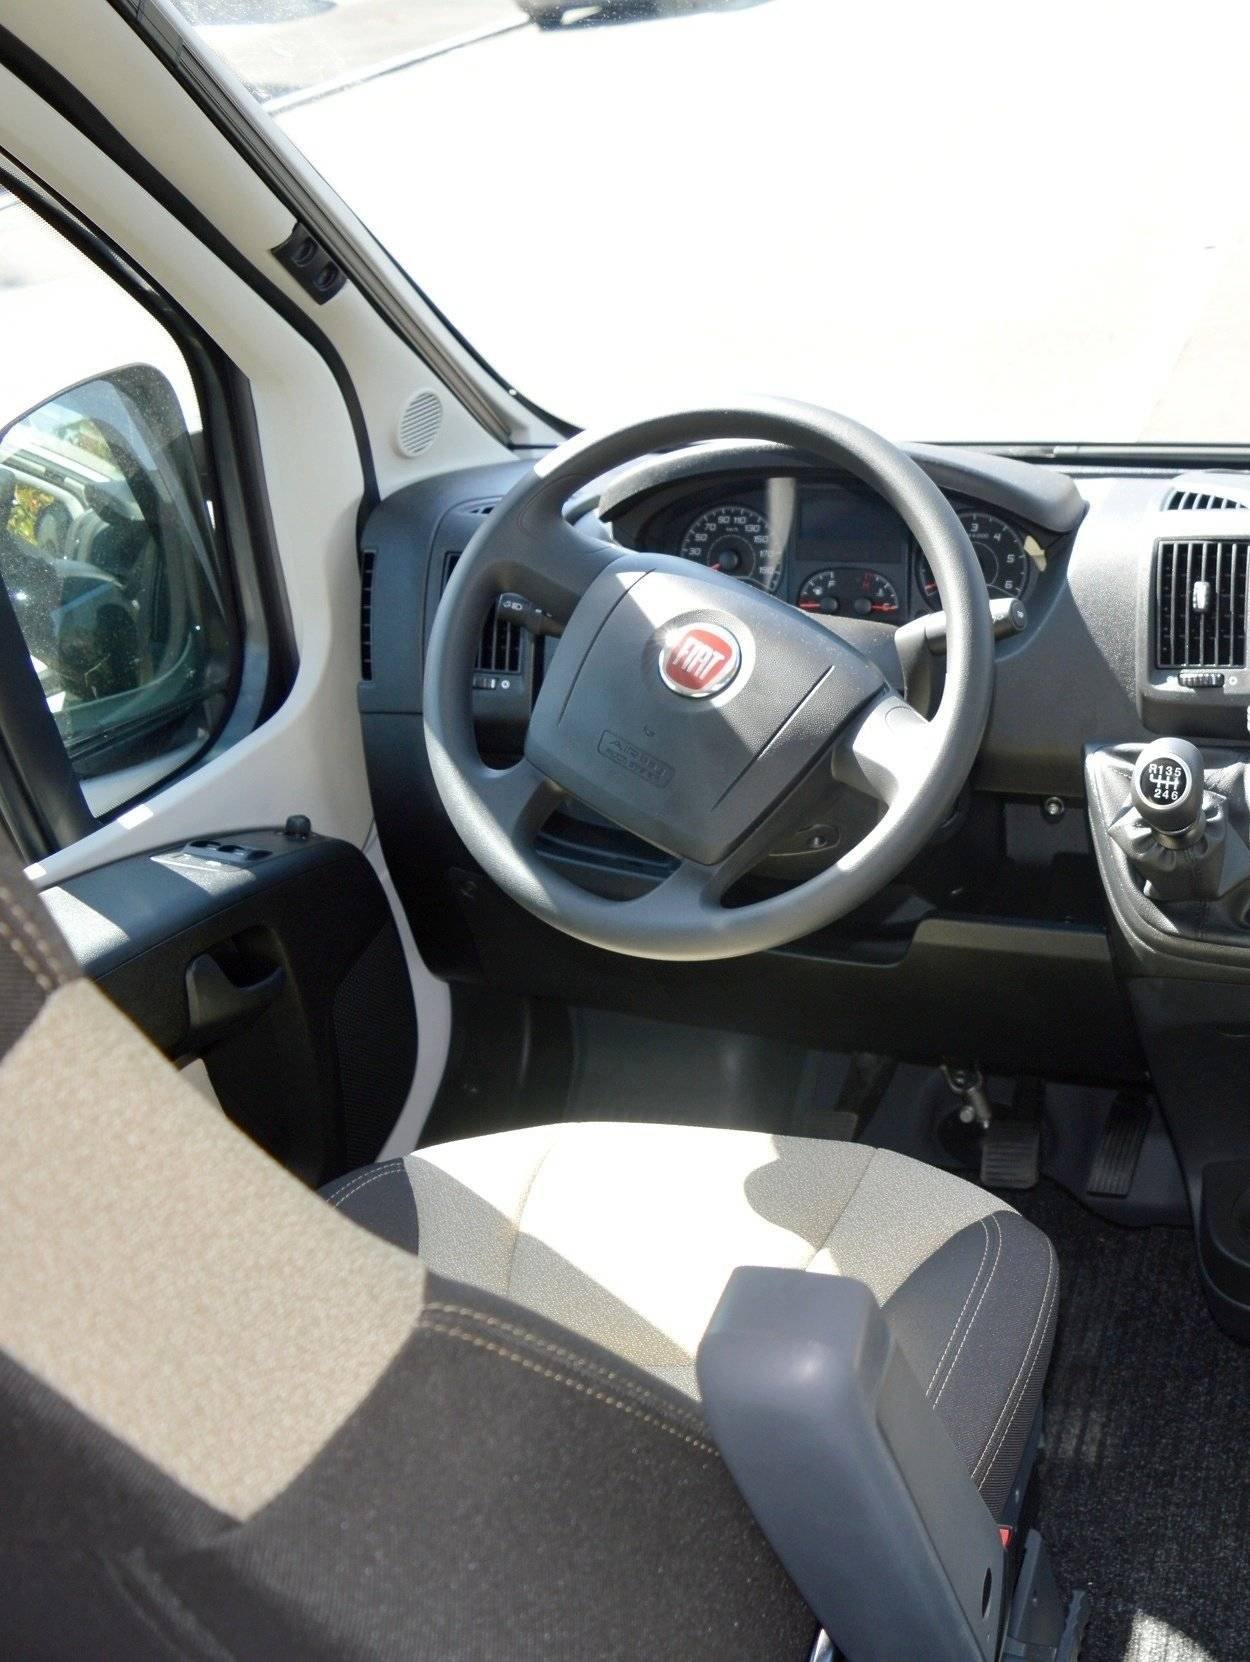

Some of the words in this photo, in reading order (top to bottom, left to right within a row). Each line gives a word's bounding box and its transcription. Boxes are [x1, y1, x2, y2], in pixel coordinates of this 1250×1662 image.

[705, 523, 716, 531] 70
[971, 523, 979, 532] 3
[993, 533, 1001, 542] 4
[689, 547, 701, 556] 30
[1007, 554, 1015, 563] 5
[1004, 580, 1012, 589] 6
[671, 636, 726, 680] FIAT
